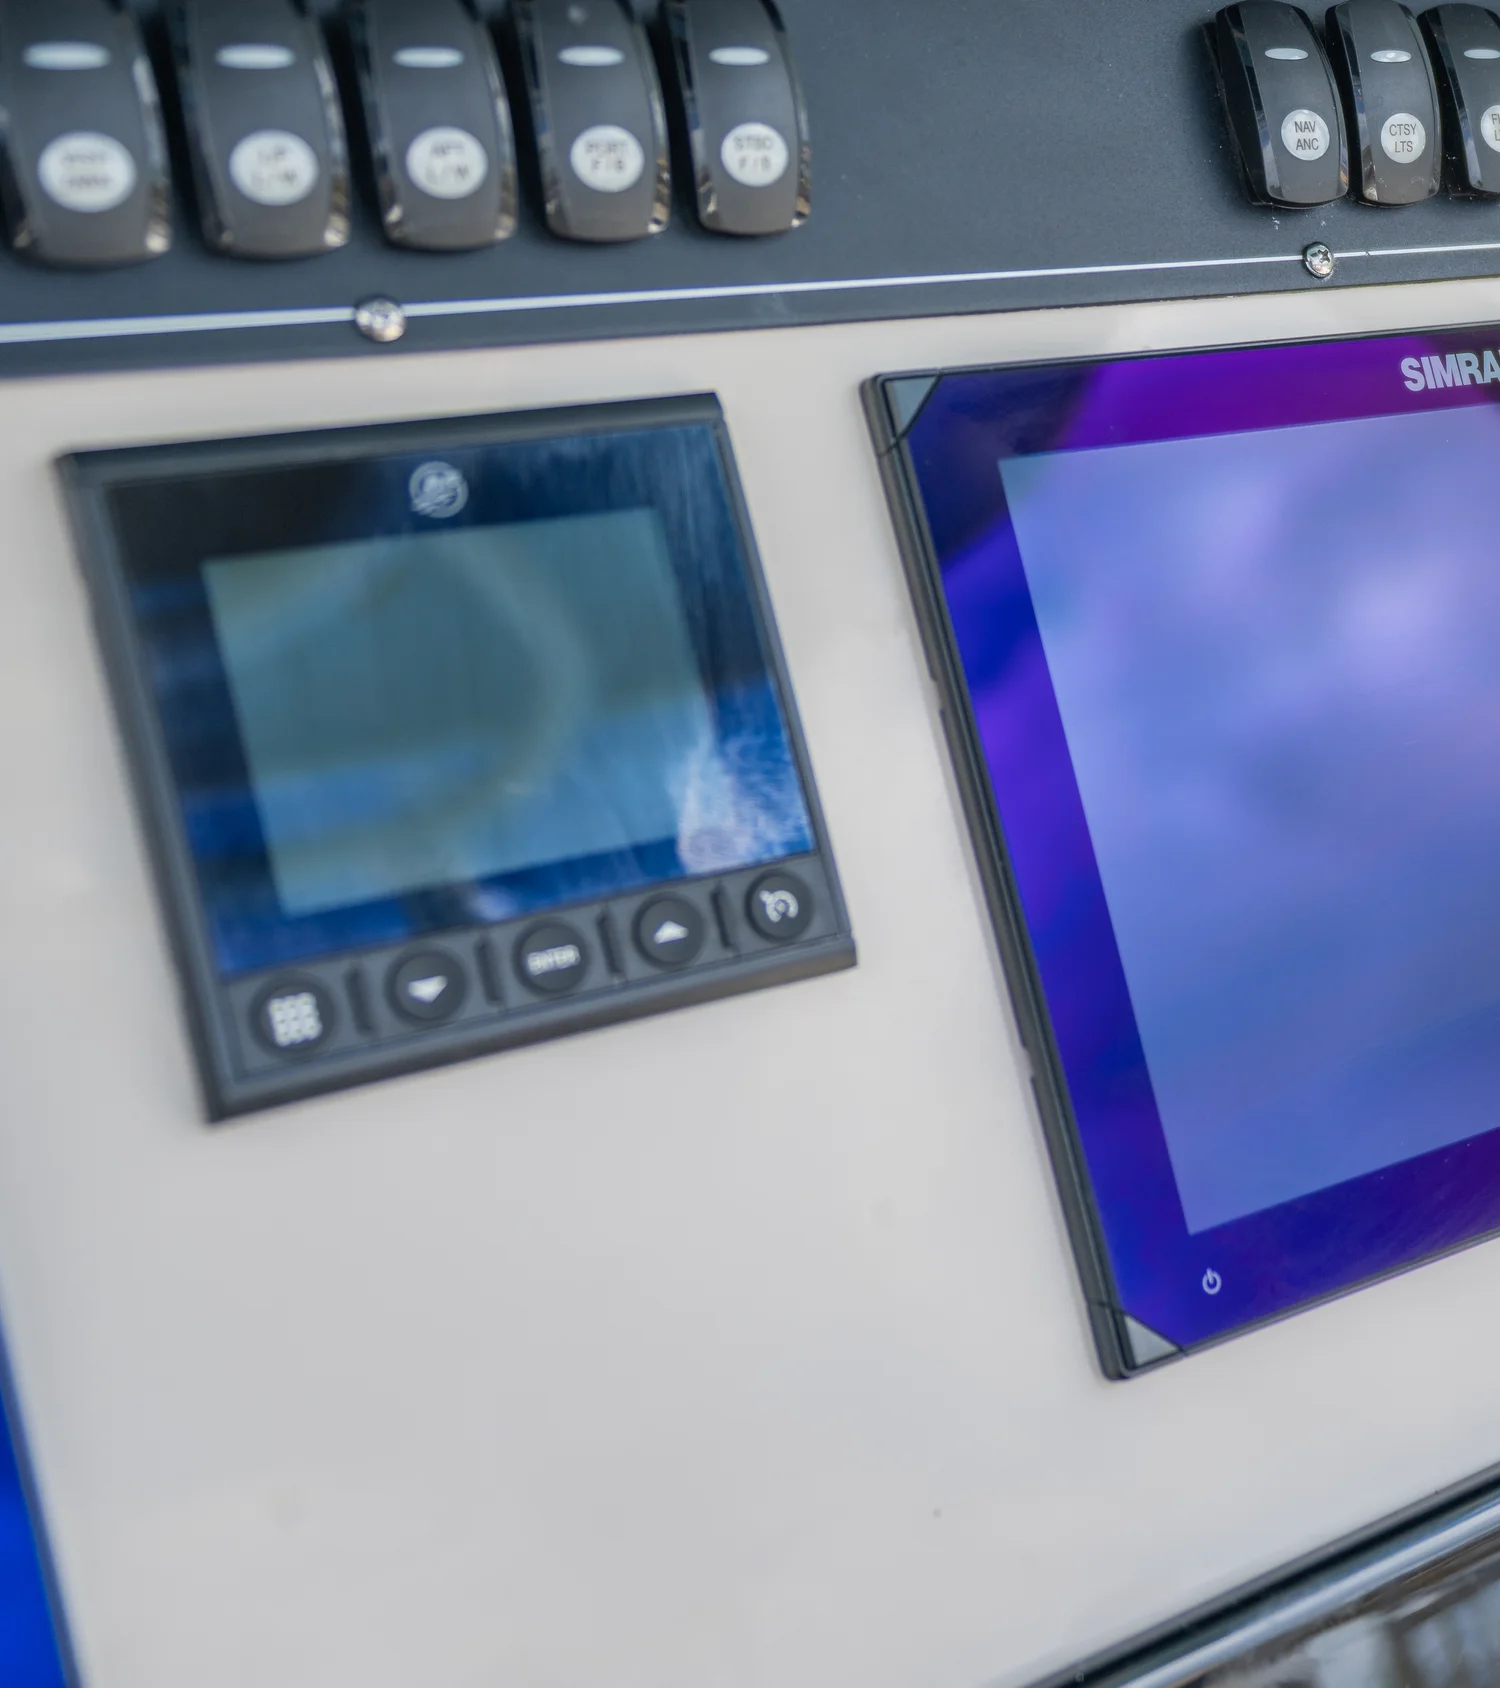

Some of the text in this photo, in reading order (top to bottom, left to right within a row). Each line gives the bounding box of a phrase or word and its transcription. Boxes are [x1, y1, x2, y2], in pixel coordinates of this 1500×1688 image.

[1294, 120, 1316, 133] NAV
[1389, 123, 1417, 137] CTSY
[1295, 138, 1319, 151] ANC
[1394, 140, 1414, 153] LTS
